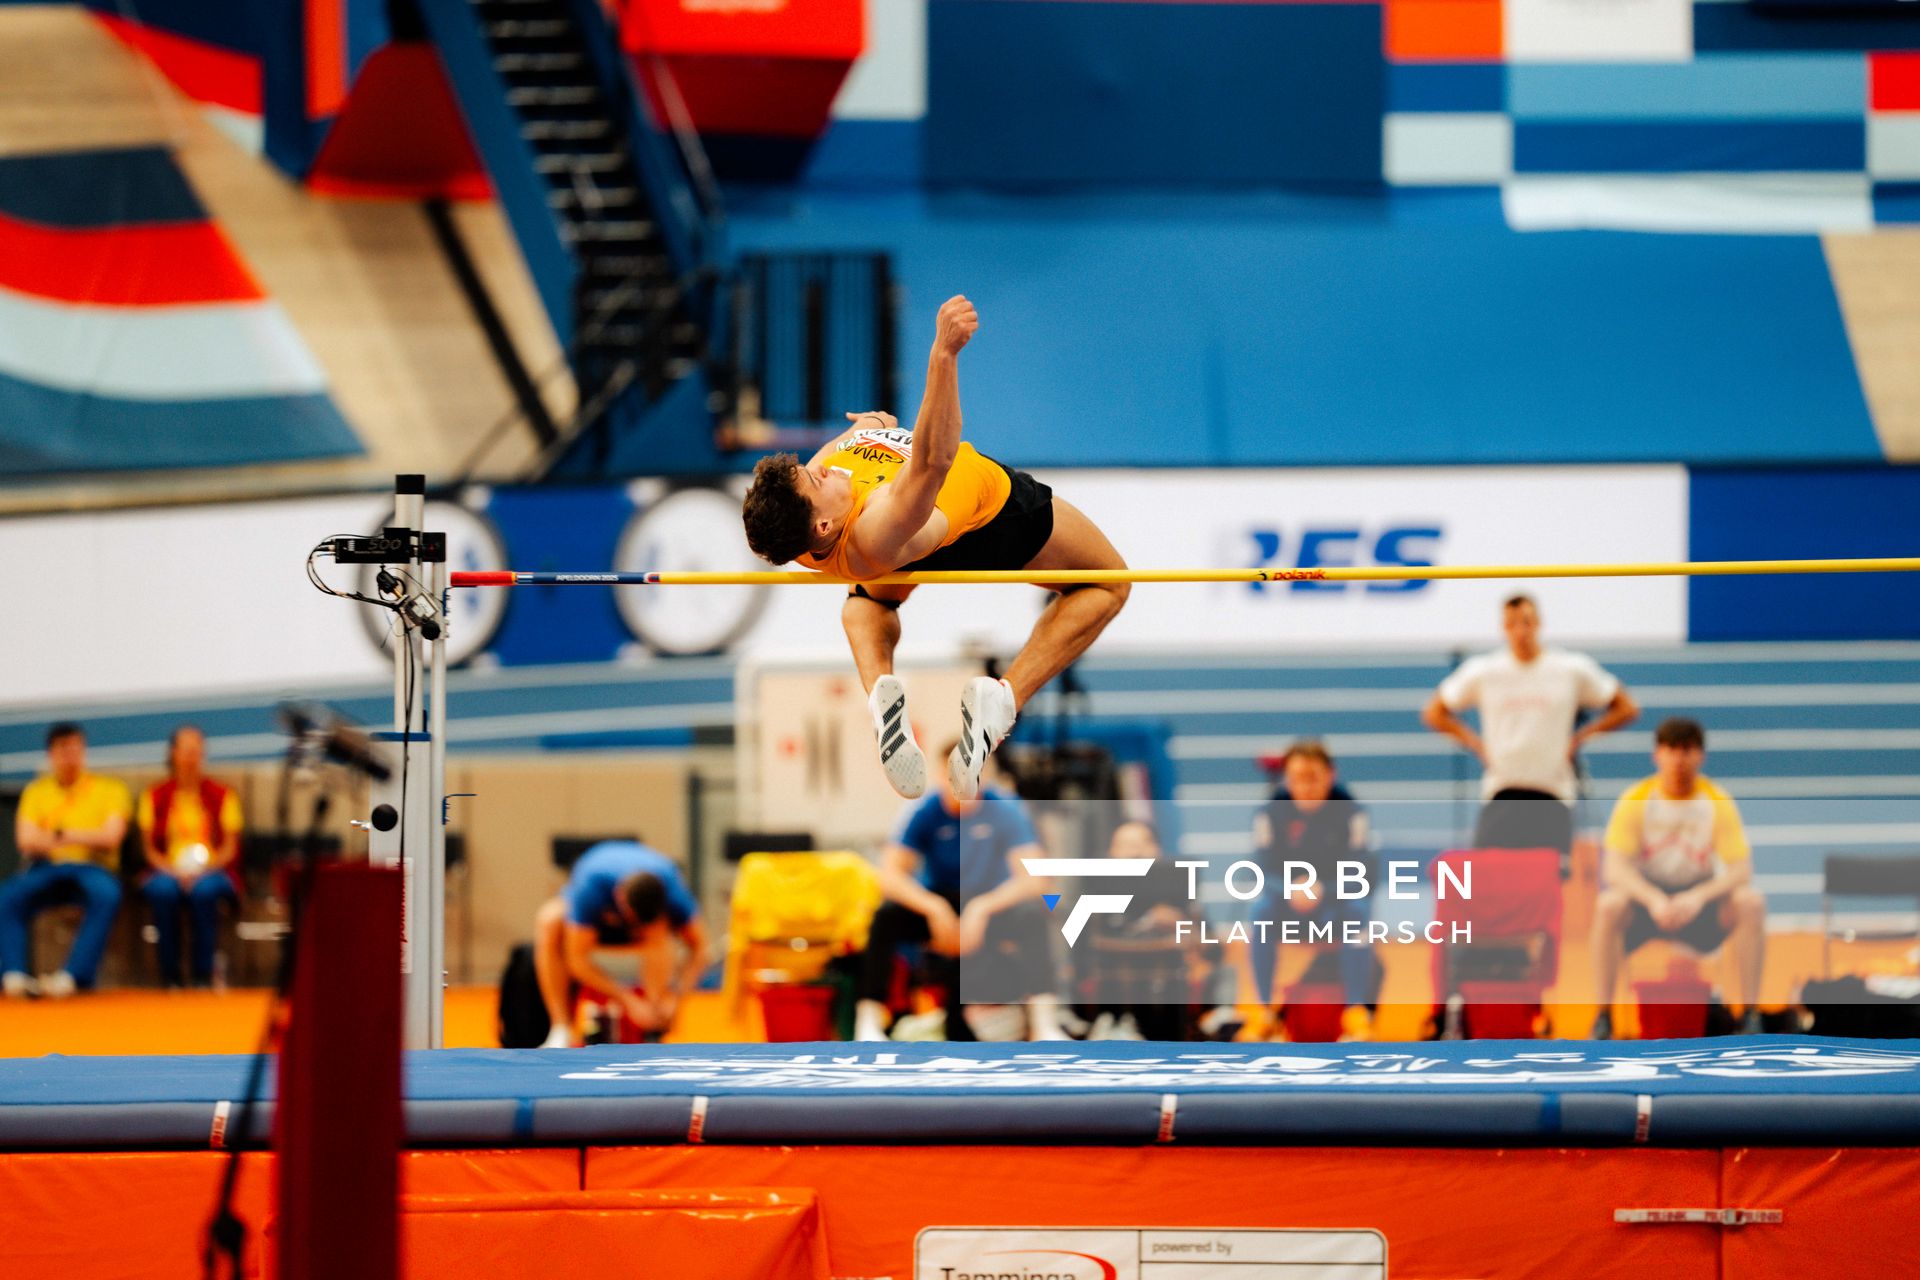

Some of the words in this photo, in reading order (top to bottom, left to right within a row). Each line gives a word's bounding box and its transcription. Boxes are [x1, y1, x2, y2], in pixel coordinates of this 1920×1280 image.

[555, 574, 601, 582] APELDOORN
[1272, 569, 1326, 581] polanik
[1152, 1241, 1212, 1256] powered
[1216, 1241, 1233, 1256] by
